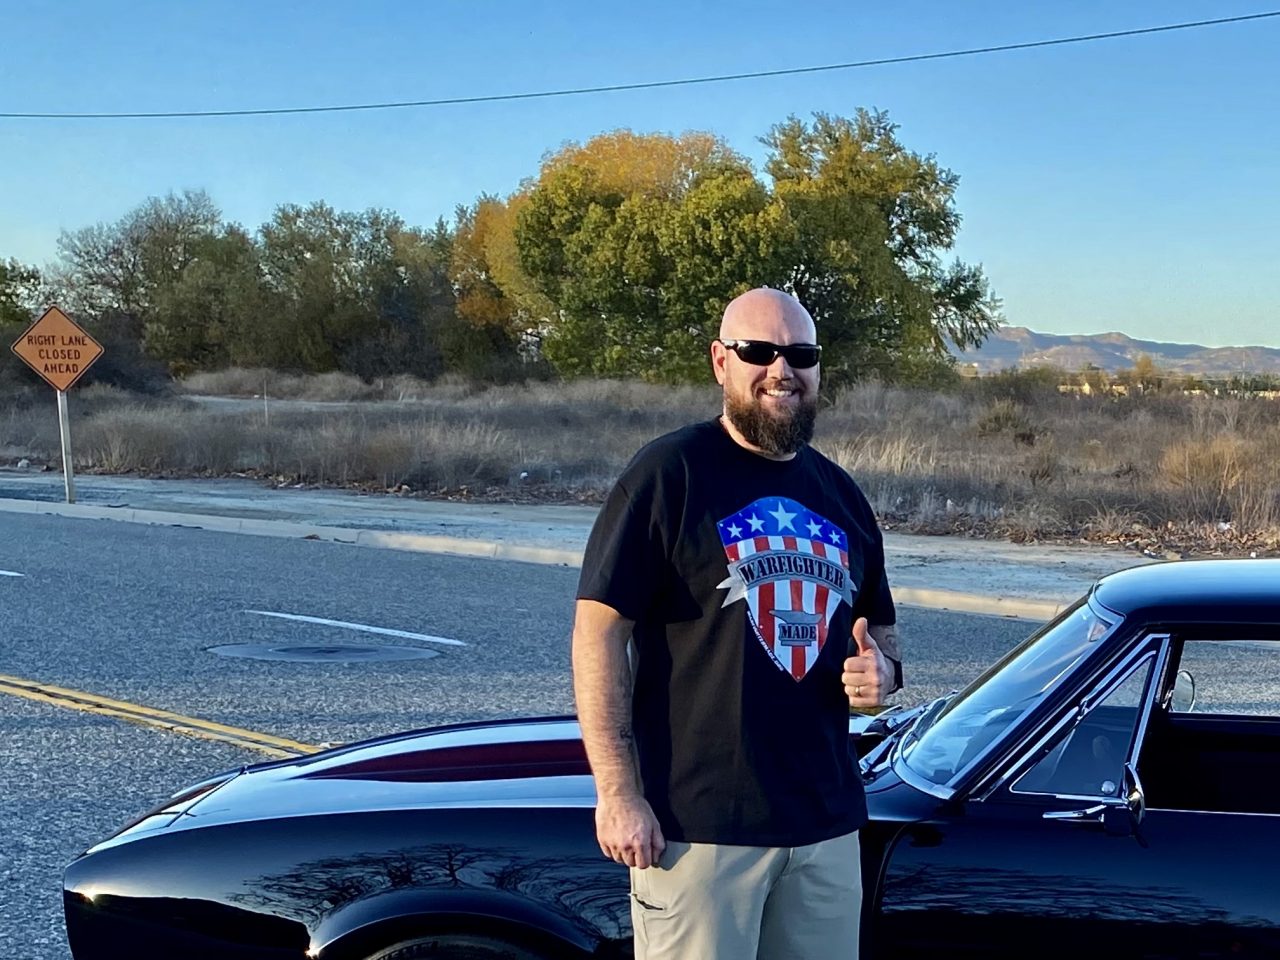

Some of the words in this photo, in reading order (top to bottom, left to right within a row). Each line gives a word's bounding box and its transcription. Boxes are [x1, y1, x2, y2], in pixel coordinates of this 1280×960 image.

[27, 335, 56, 345] RIGHT
[61, 335, 88, 346] LANE
[38, 349, 81, 360] CLOSED
[43, 363, 79, 374] AHEAD
[739, 555, 844, 589] WARFIGHTER
[781, 625, 817, 641] MADE
